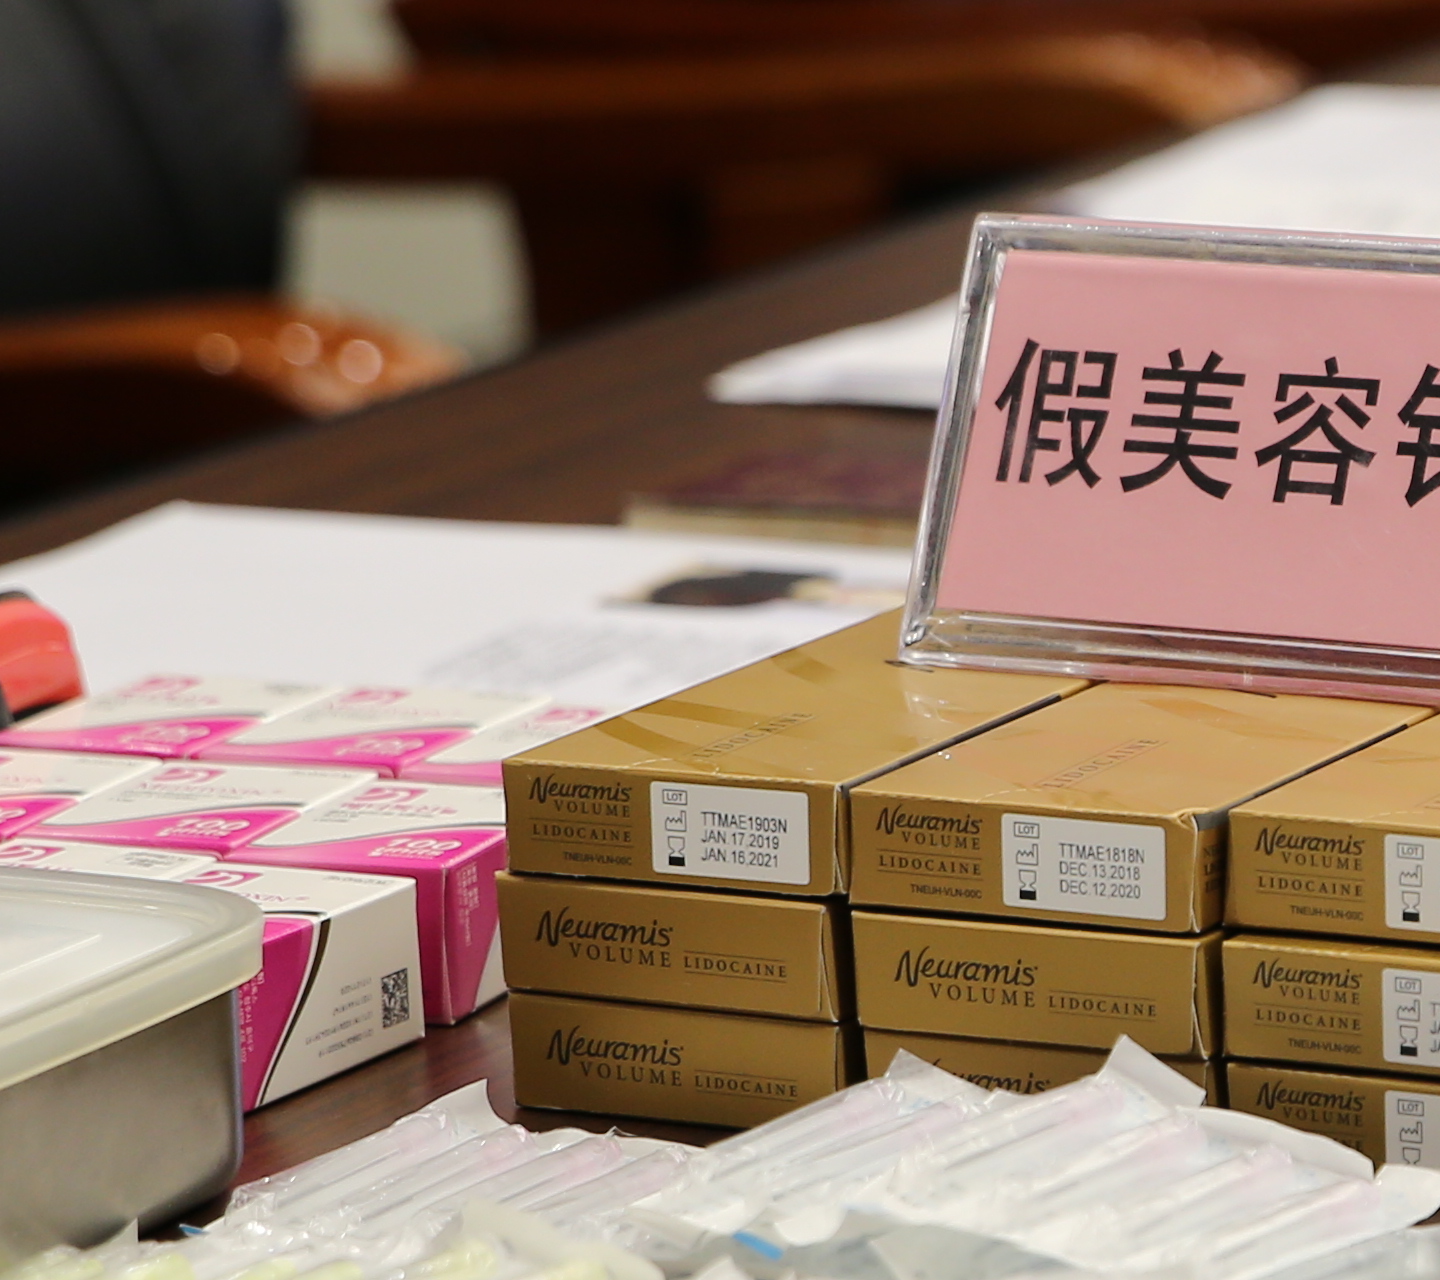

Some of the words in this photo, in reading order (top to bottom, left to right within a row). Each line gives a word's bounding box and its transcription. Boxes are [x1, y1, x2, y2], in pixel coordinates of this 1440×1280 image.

[694, 713, 813, 759] LIDOCAINE
[1044, 738, 1160, 789] LIDOCAINE
[529, 774, 632, 804] Neuramis
[666, 792, 684, 802] LOT
[554, 800, 631, 818] VOLUME
[875, 806, 982, 834] Neuramis
[176, 818, 251, 832] 100
[532, 824, 632, 842] LIDOCAINE
[700, 811, 788, 834] TTMAE1903N
[1018, 825, 1037, 836] LOT
[386, 838, 462, 852] 100
[901, 831, 981, 850] VOLUME
[1254, 825, 1364, 856] Neuramis
[1400, 846, 1420, 857] LOT
[1058, 842, 1145, 865] TTMAE1818N
[1281, 852, 1363, 871] VOLUME
[878, 855, 981, 876] LIDOCAINE
[1259, 877, 1363, 897] LIDOCAINE
[535, 906, 673, 947] Neuramis
[569, 942, 672, 968] VOLUME
[683, 955, 788, 979] LIDOCAINE
[894, 946, 1038, 987] Neuramis
[1253, 958, 1362, 989] Neuramis
[1279, 985, 1360, 1005] VOLUME
[1399, 981, 1418, 992] LOT
[929, 982, 1036, 1008] VOLUME
[1049, 995, 1157, 1017] LIDOCAINE
[1257, 1009, 1360, 1031] LIDOCAINE
[546, 1025, 684, 1066] Neuramis
[580, 1061, 682, 1087] VOLUME
[694, 1074, 798, 1097] LIDOCAINE
[1256, 1080, 1365, 1111] Neuramis
[1283, 1107, 1363, 1127] VOLUME
[1401, 1102, 1420, 1113] LOT
